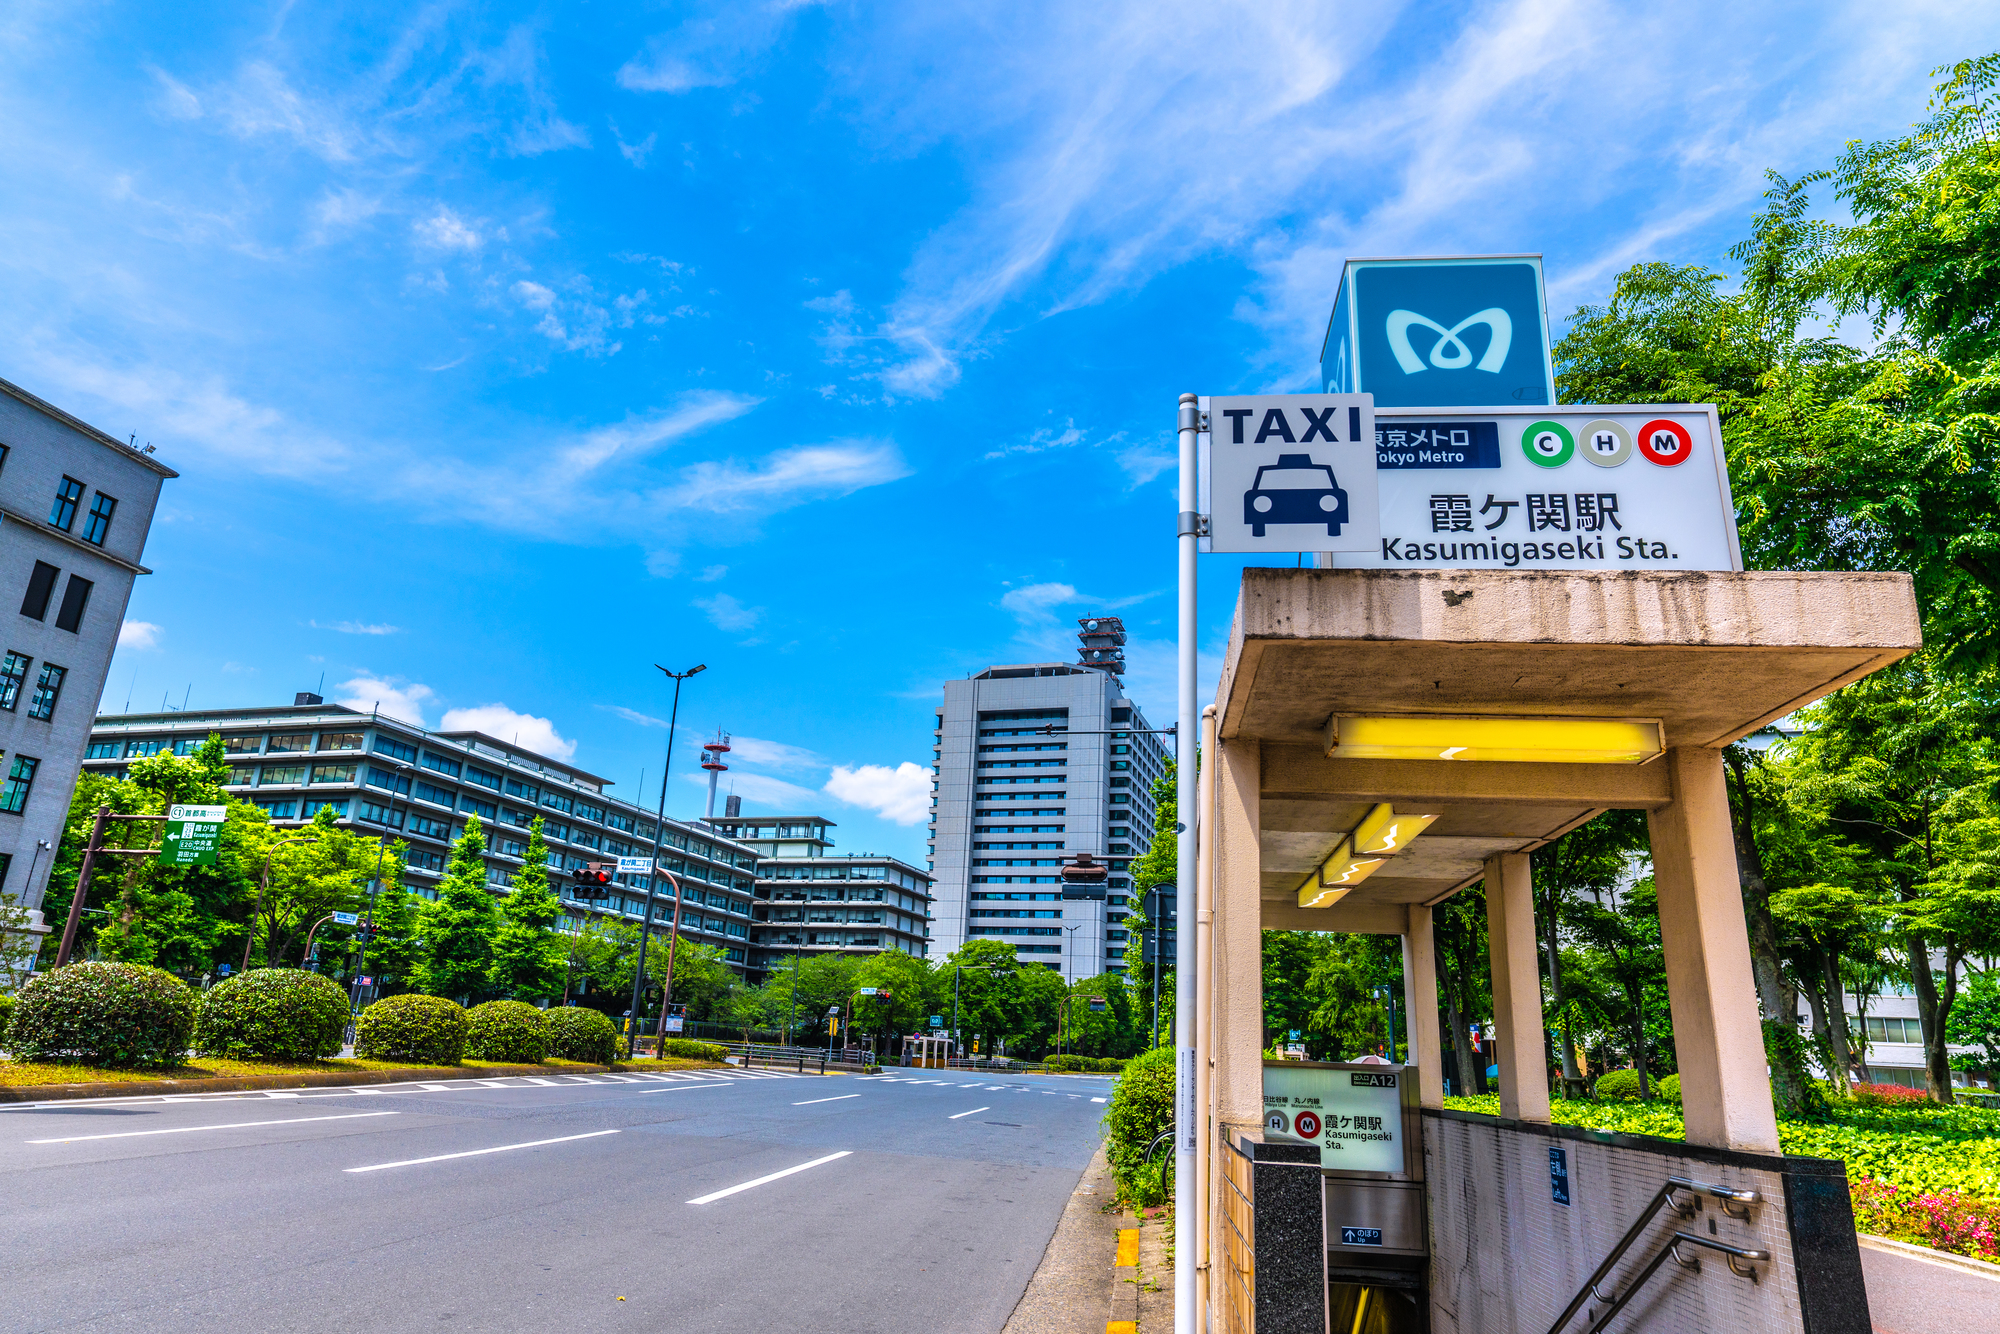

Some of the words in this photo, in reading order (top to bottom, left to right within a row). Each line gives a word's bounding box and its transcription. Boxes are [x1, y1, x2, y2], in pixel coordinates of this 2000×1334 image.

[1223, 406, 1362, 444] TAXI
[1539, 436, 1553, 452] C
[1597, 435, 1614, 451] H
[1654, 435, 1677, 451] M
[1419, 450, 1464, 463] Metro
[1430, 493, 1622, 533] 霞ケ関駅
[1382, 536, 1604, 566] Kasumigaseki
[1616, 537, 1678, 559] Sta.
[1369, 1075, 1395, 1087] A12
[1294, 1097, 1320, 1105] 丸ノ内線
[1272, 1119, 1280, 1129] H
[1302, 1120, 1313, 1130] M
[1325, 1115, 1382, 1131] 霞ケ関駅
[1325, 1130, 1392, 1142] Kasumigaseki
[1326, 1141, 1343, 1150] Sta.
[1357, 1230, 1379, 1238] のぼり
